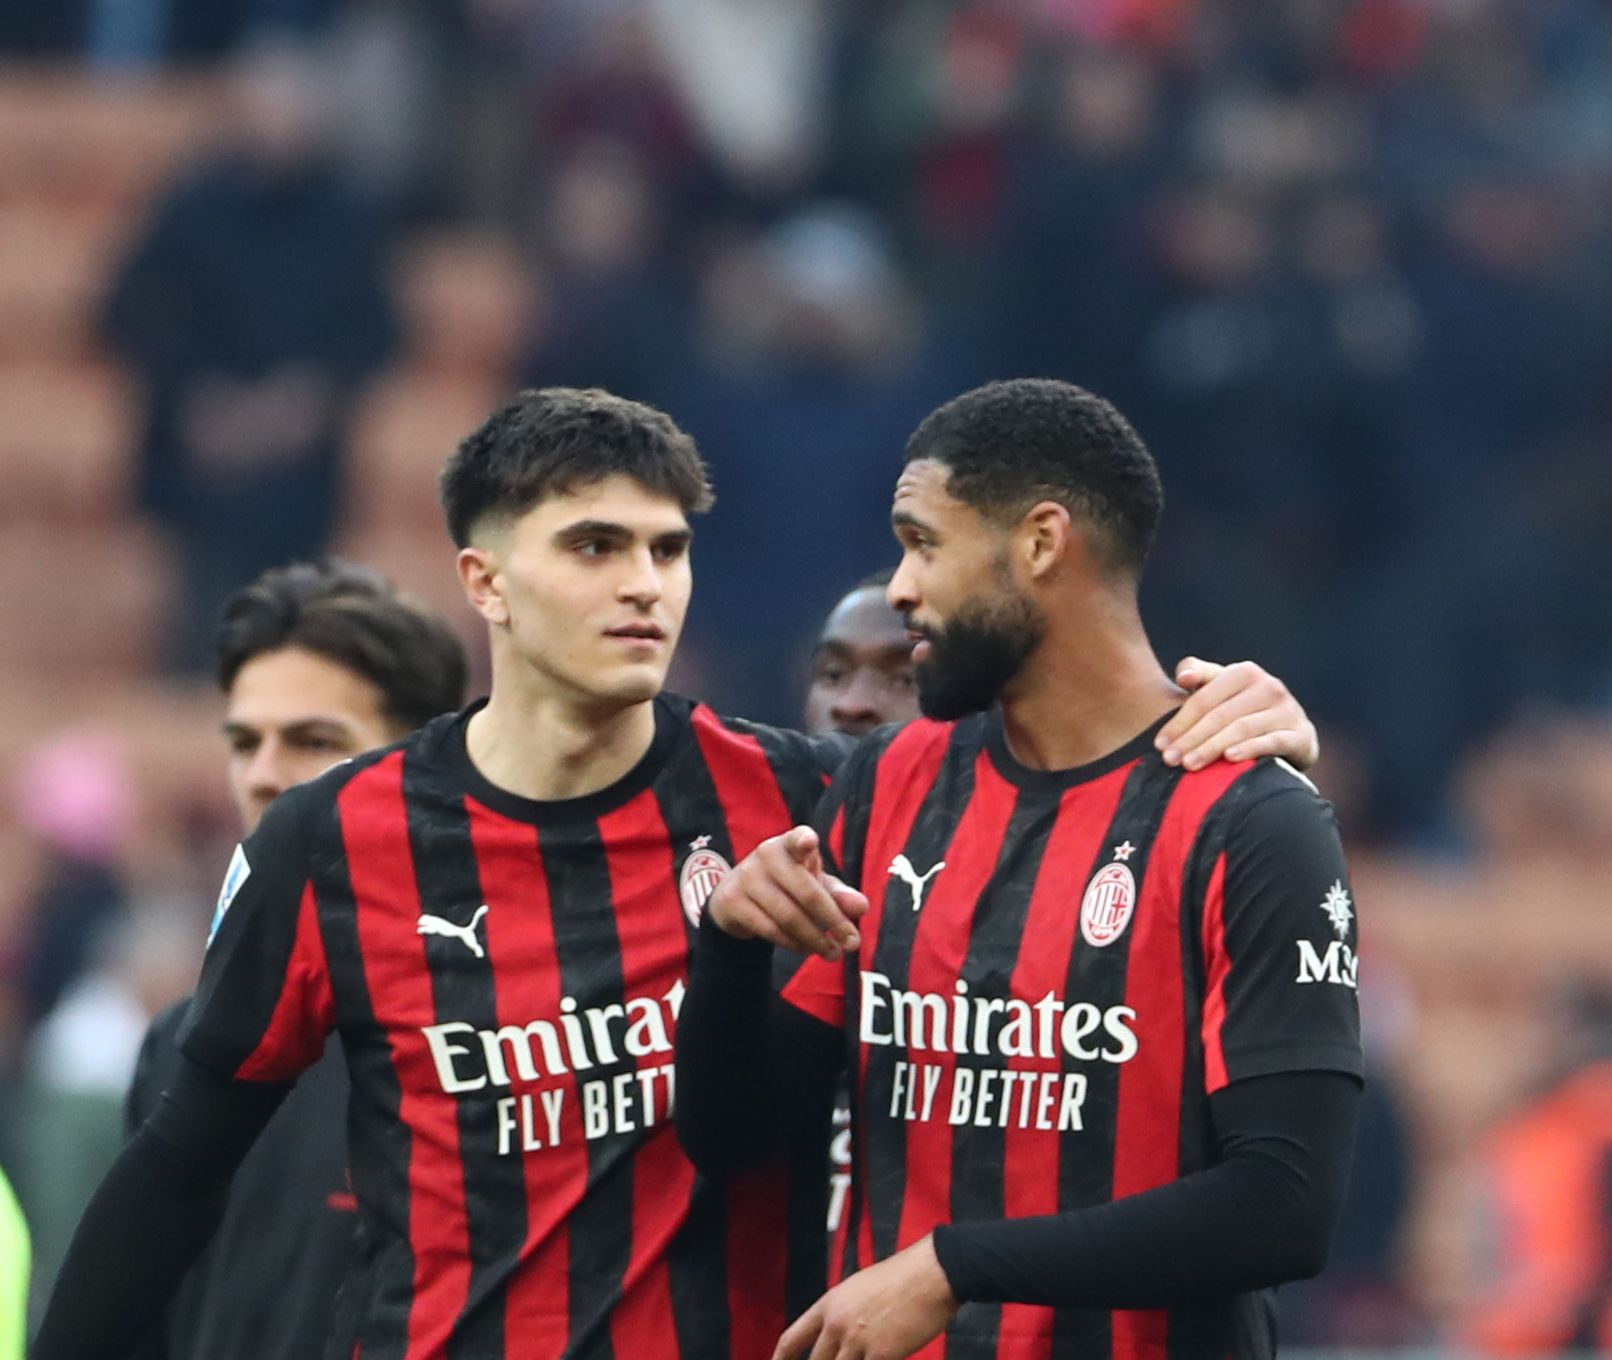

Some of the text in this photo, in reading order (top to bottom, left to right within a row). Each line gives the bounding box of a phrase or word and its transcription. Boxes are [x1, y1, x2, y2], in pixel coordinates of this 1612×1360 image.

[1295, 939, 1359, 991] MS
[859, 970, 1139, 1064] Emirates
[497, 1063, 676, 1156] FLY BETT
[889, 1060, 1088, 1132] FLY BETTER
